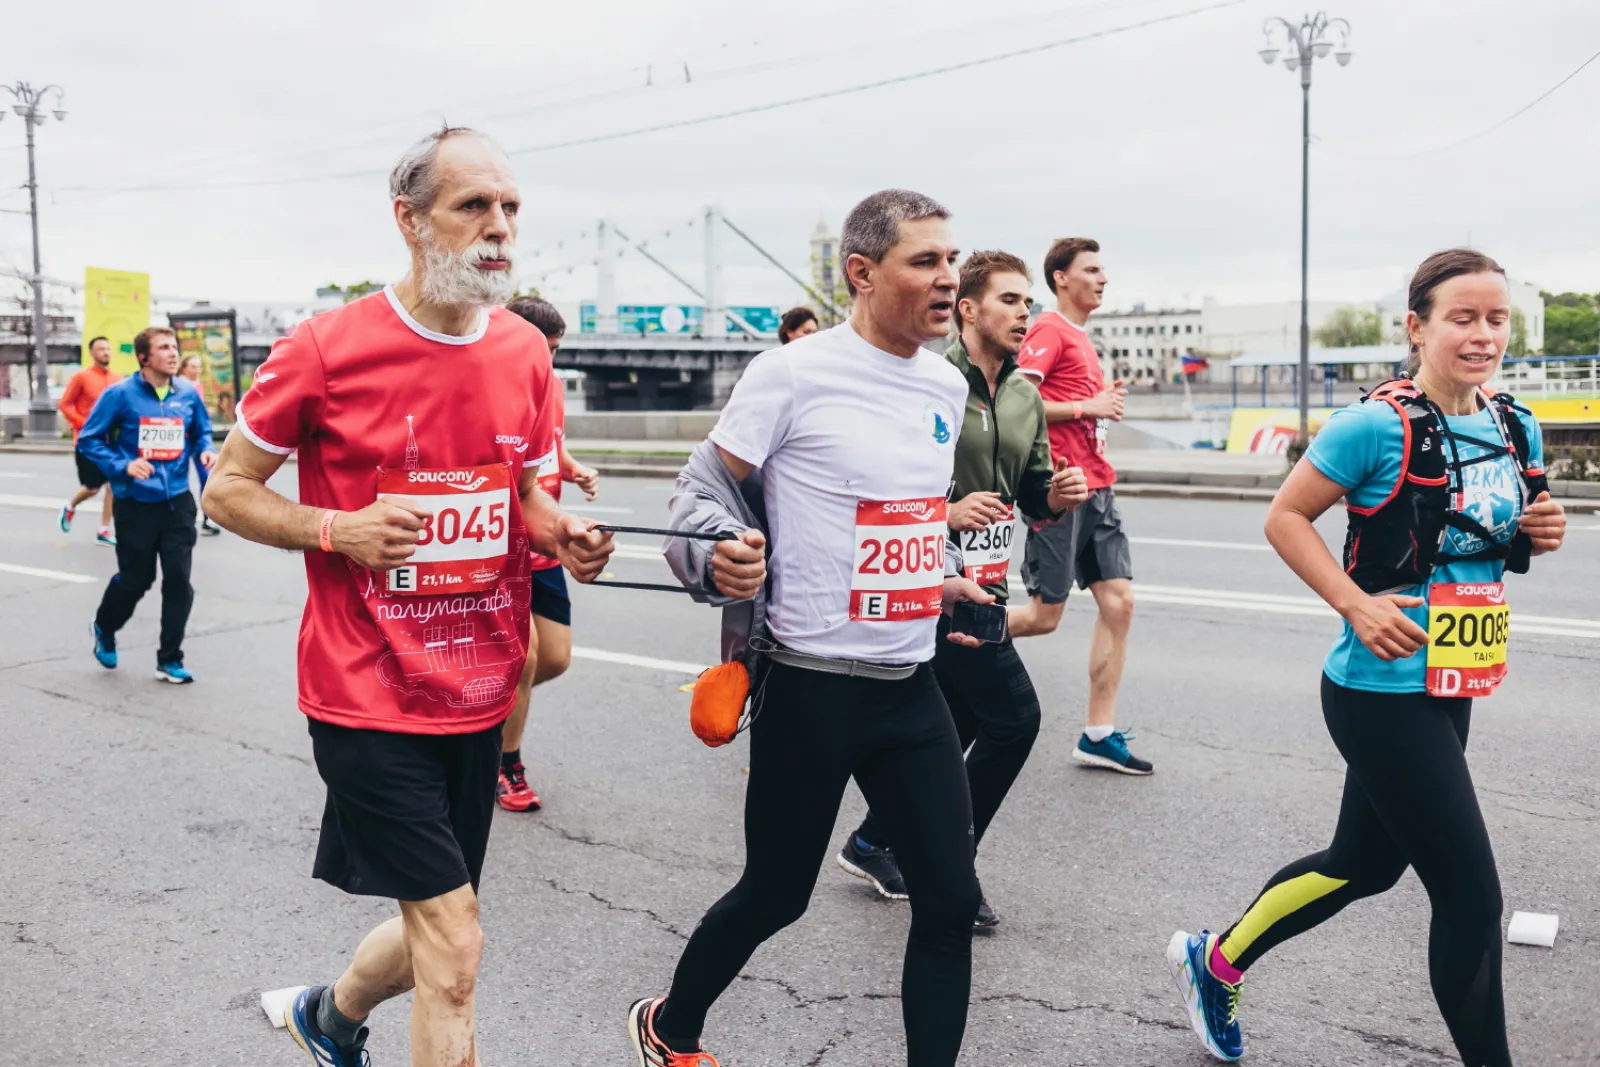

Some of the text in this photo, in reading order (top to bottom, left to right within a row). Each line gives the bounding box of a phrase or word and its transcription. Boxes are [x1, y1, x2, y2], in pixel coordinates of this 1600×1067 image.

[142, 428, 182, 441] 27087
[408, 470, 475, 483] saucony
[882, 501, 928, 514] saucony
[414, 502, 505, 546] 8045
[858, 534, 945, 574] 28050
[396, 569, 410, 589] E
[867, 597, 882, 616] E
[1434, 612, 1509, 648] 20085
[1441, 669, 1461, 695] D
